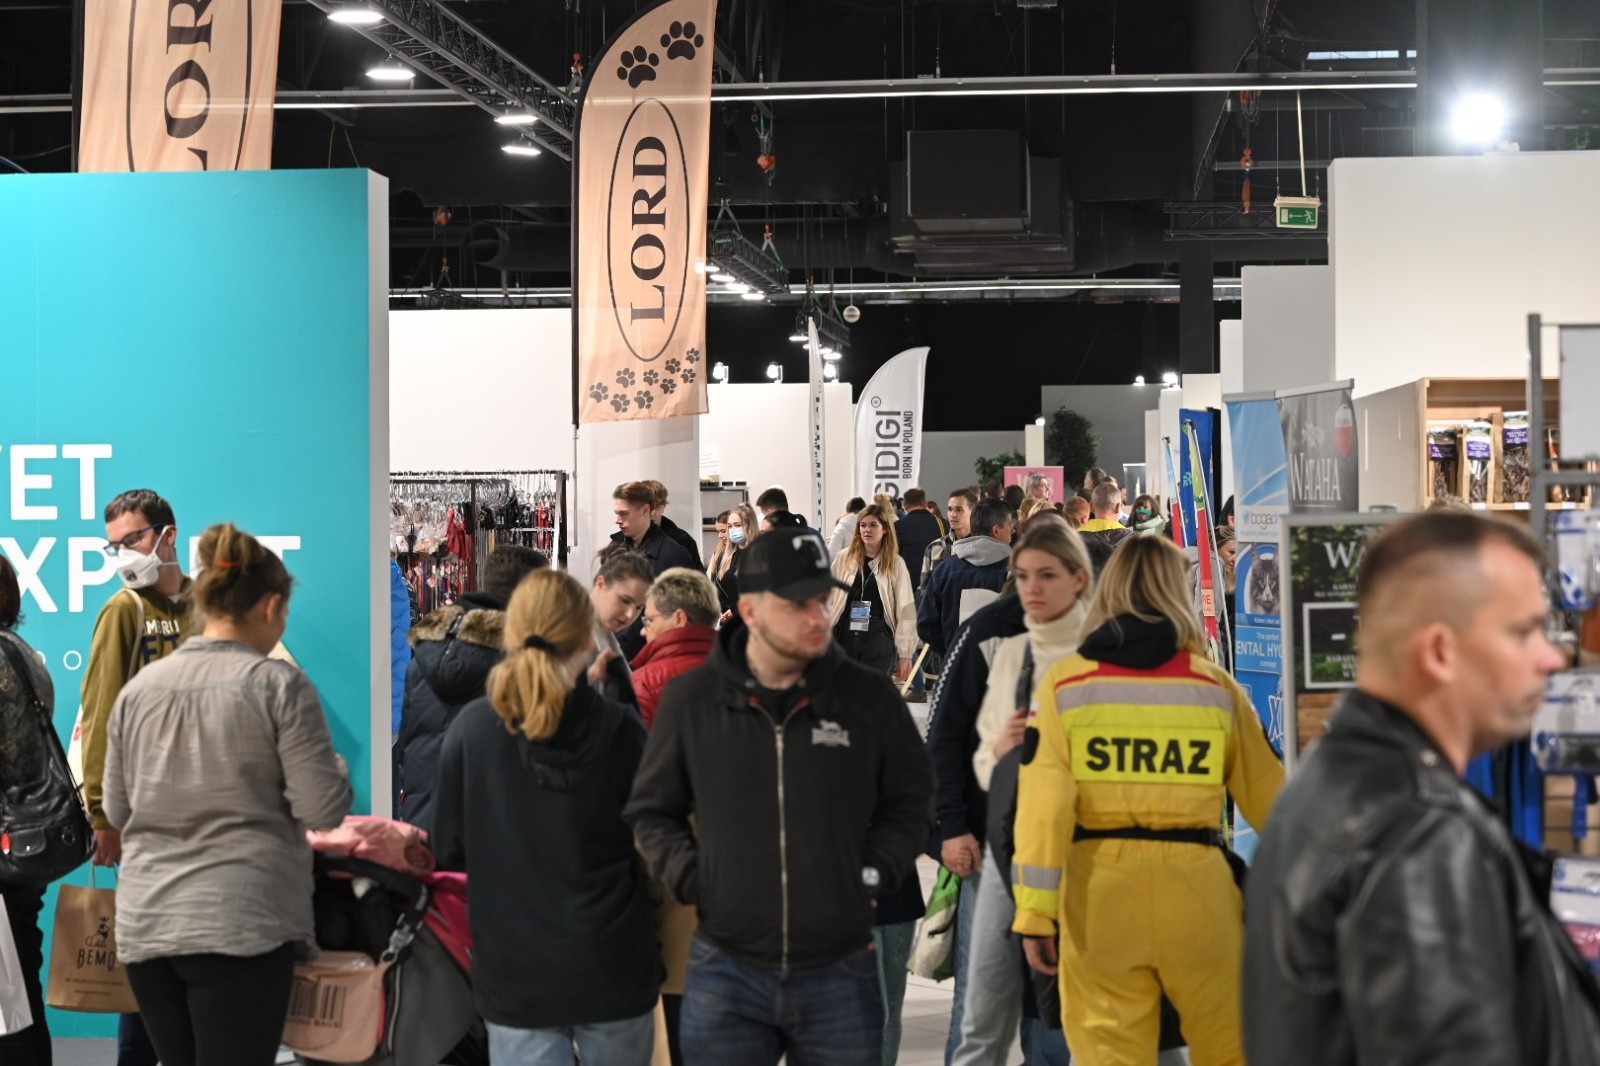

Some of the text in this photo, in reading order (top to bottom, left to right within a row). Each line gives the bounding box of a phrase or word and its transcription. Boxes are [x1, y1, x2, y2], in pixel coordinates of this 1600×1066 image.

[630, 136, 668, 325] LORD
[0, 444, 112, 520] ET
[903, 411, 914, 480] BORN IN POLAND
